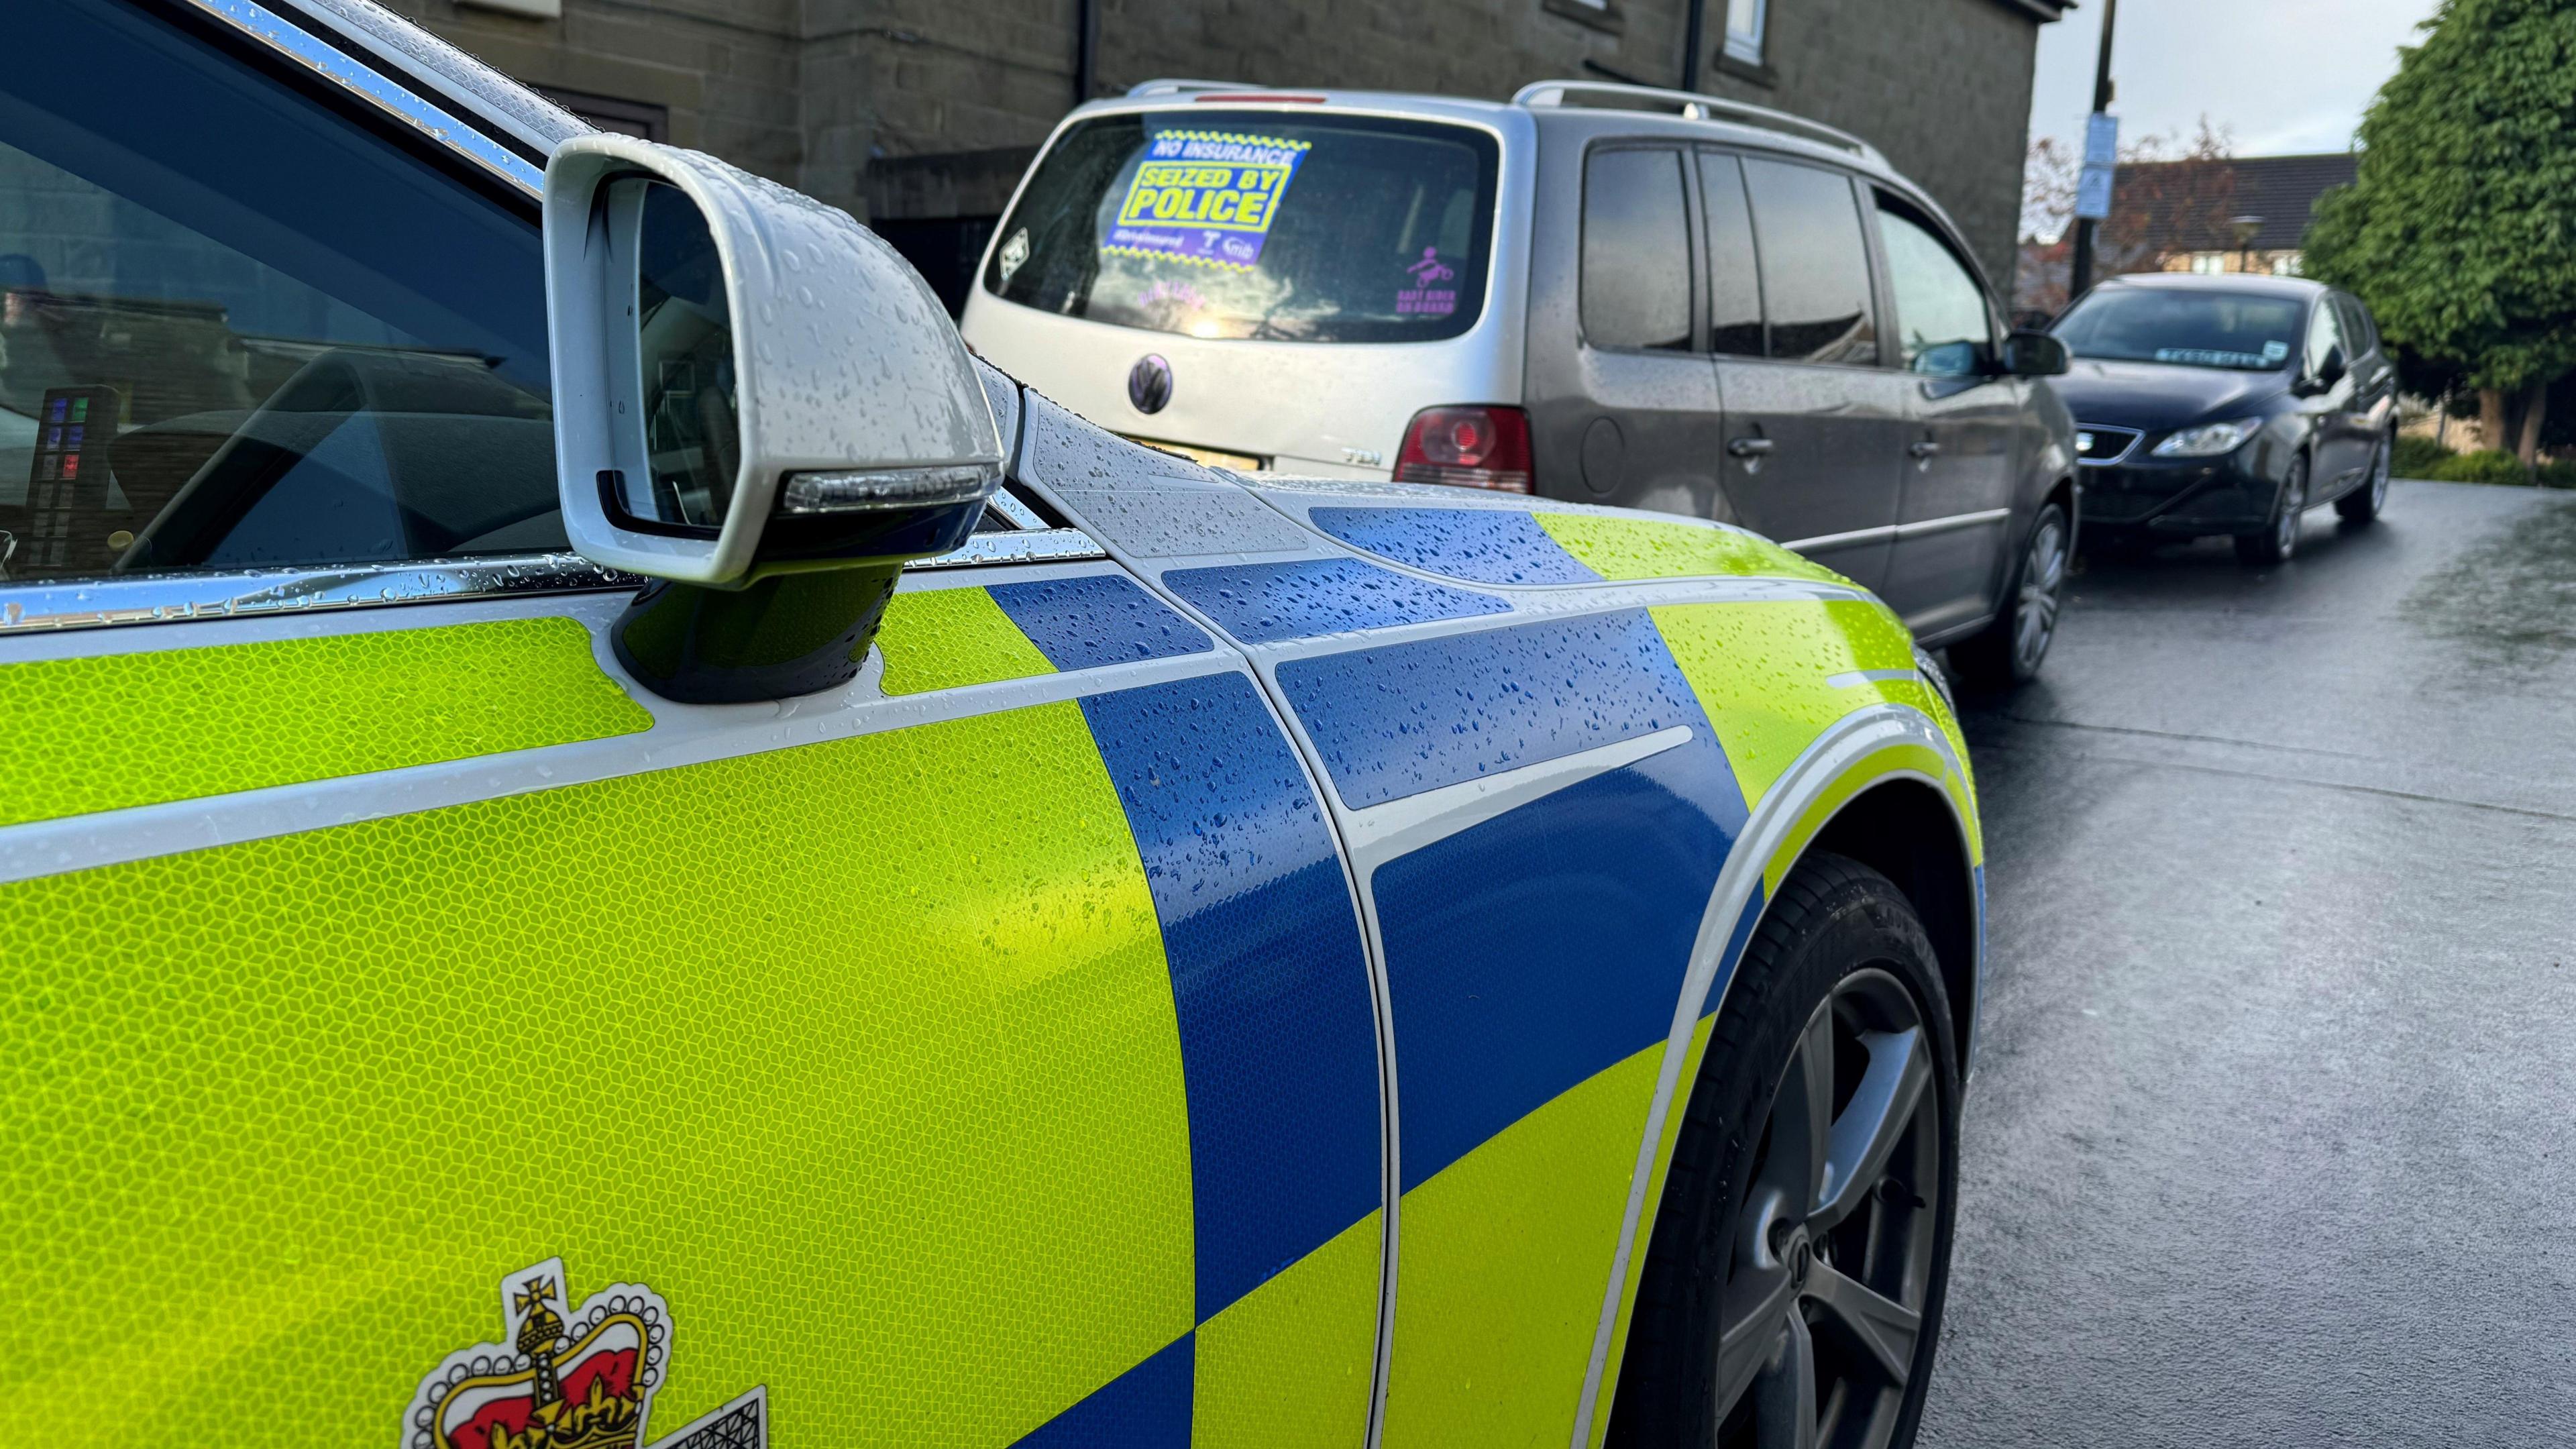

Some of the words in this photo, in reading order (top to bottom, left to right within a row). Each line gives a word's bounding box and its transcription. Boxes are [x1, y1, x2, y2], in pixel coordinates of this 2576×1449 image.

[1152, 140, 1183, 157] NO
[1182, 141, 1297, 166] INSURANCE
[1141, 168, 1232, 188] SEIZED
[1238, 170, 1280, 191] BY
[1128, 188, 1269, 223] POLICE
